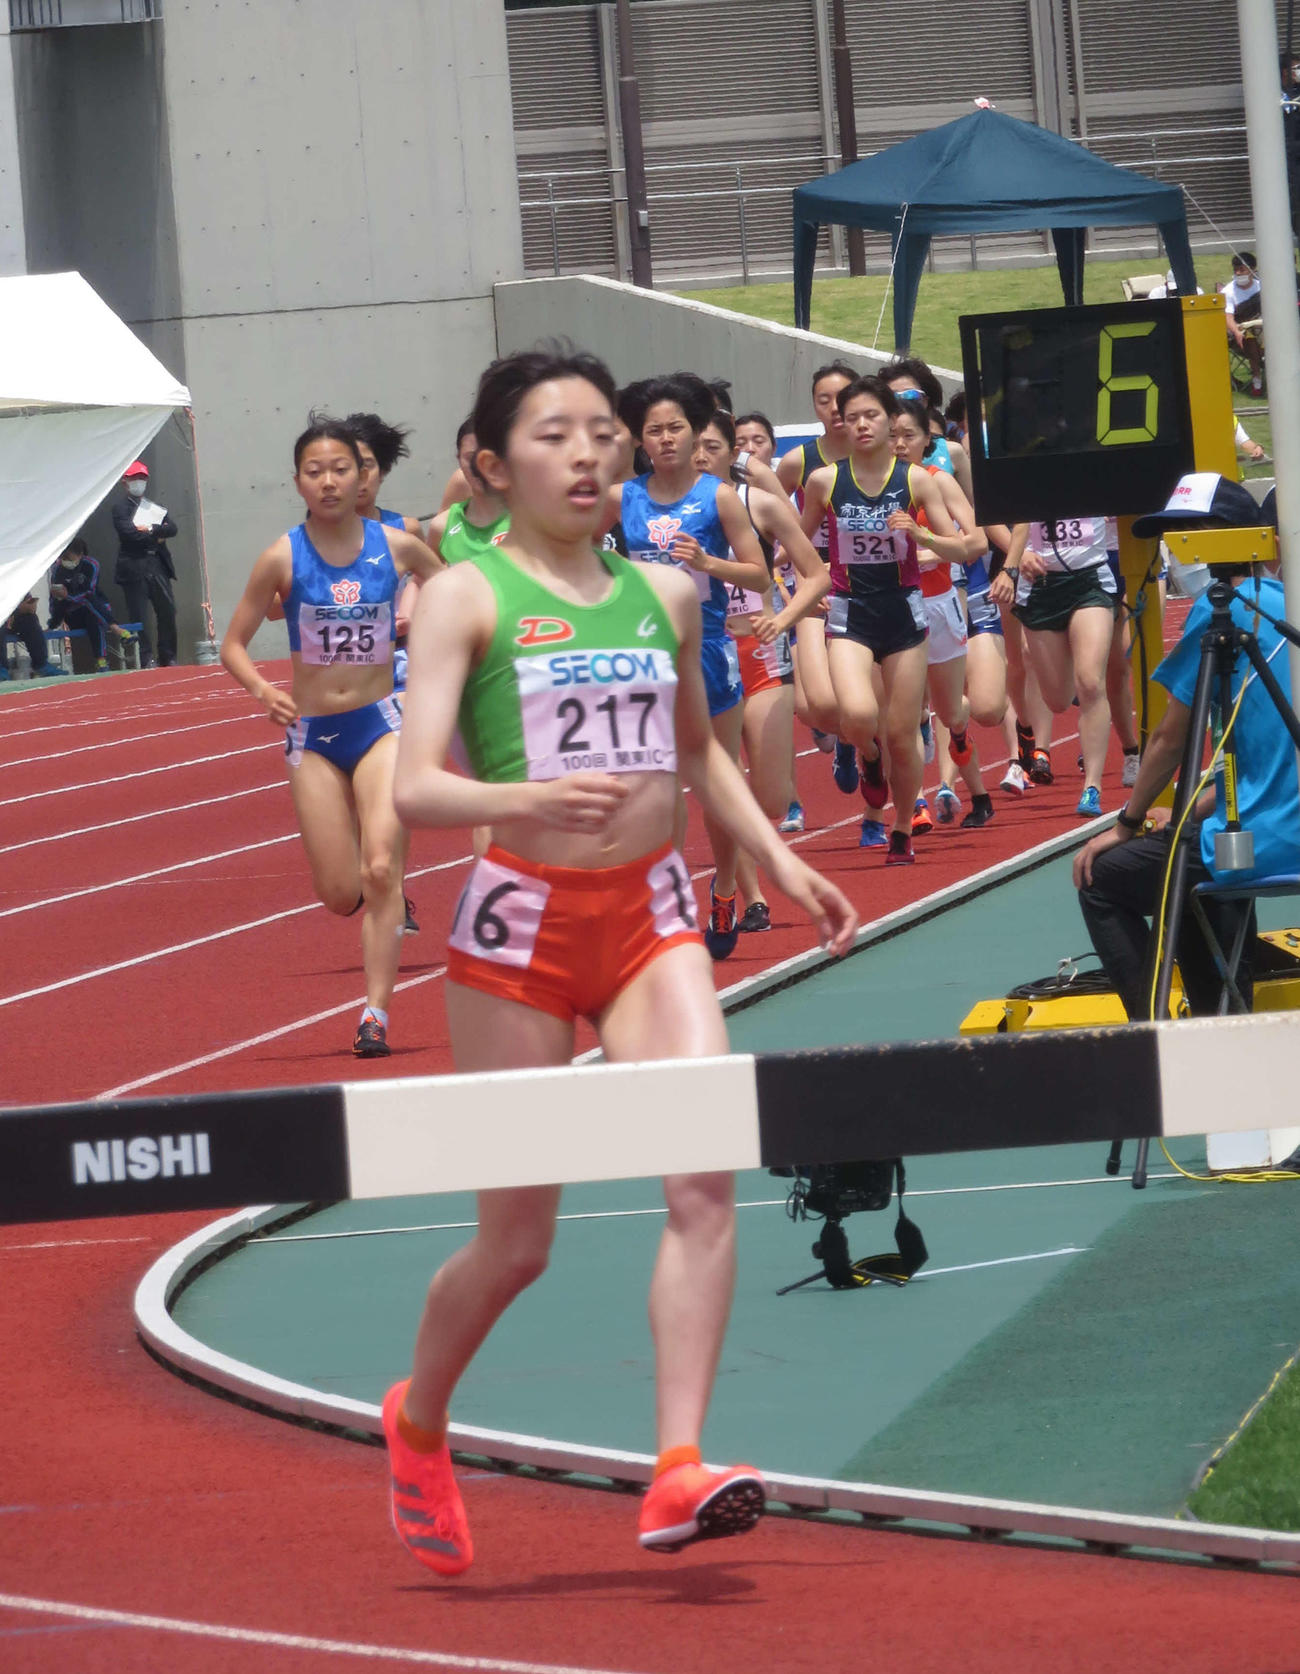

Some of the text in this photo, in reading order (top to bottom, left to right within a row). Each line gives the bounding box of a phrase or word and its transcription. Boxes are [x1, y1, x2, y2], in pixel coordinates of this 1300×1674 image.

[1097, 321, 1159, 446] 6
[853, 535, 896, 555] 521
[315, 605, 379, 620] SECOM
[317, 625, 375, 653] 125
[549, 653, 659, 686] SECOM
[556, 692, 658, 753] 217
[72, 1132, 212, 1185] NISHI
